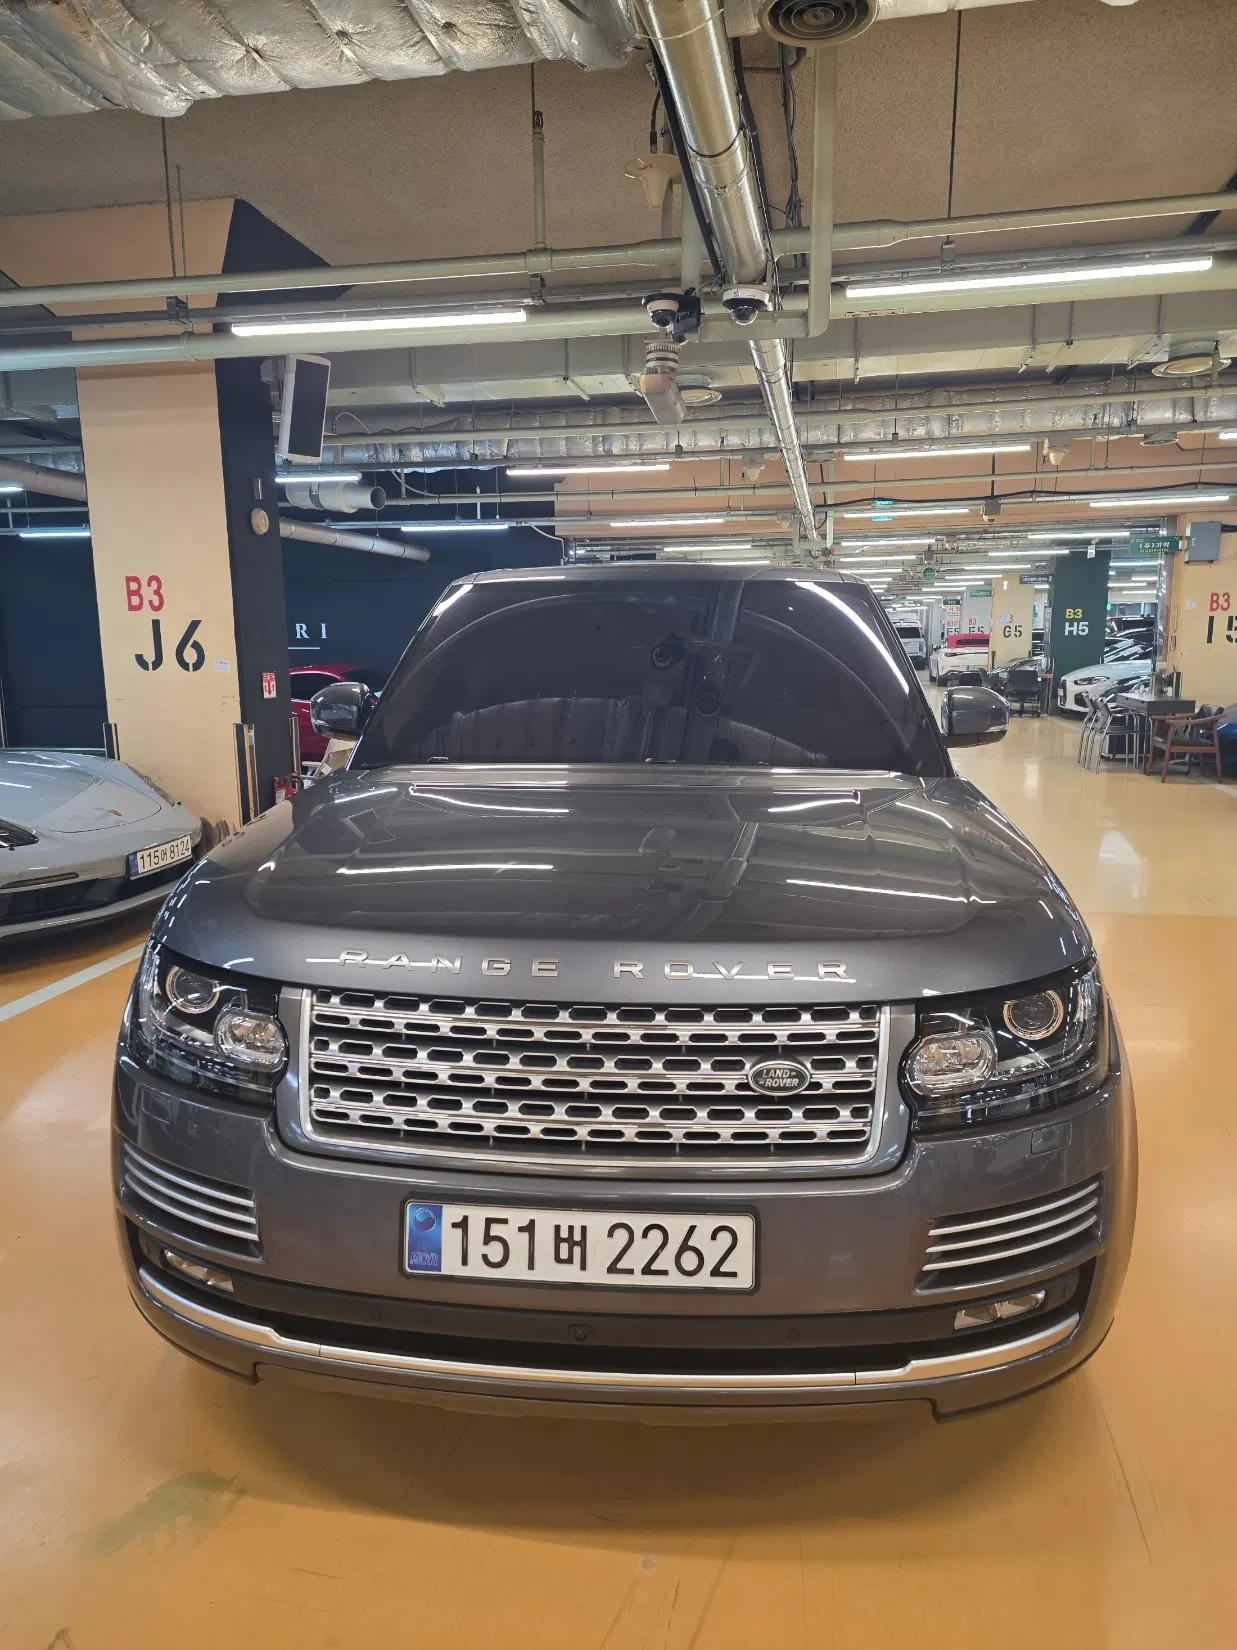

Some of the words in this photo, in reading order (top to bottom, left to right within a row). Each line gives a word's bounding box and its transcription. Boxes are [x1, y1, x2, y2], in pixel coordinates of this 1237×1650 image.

[125, 574, 165, 613] B3
[1209, 592, 1231, 612] B3
[1065, 608, 1083, 619] B3
[1003, 625, 1023, 639] G5
[1064, 621, 1089, 636] H5
[134, 618, 206, 673] J6
[139, 847, 168, 870] 115어
[169, 838, 190, 860] 8124
[338, 947, 560, 977] RANGE
[613, 959, 851, 981] ROVER
[762, 1069, 790, 1078] LAND
[764, 1078, 799, 1087] ROVER
[451, 1214, 588, 1271] 151버
[606, 1222, 739, 1278] 2262
[409, 1251, 439, 1267] KOR
